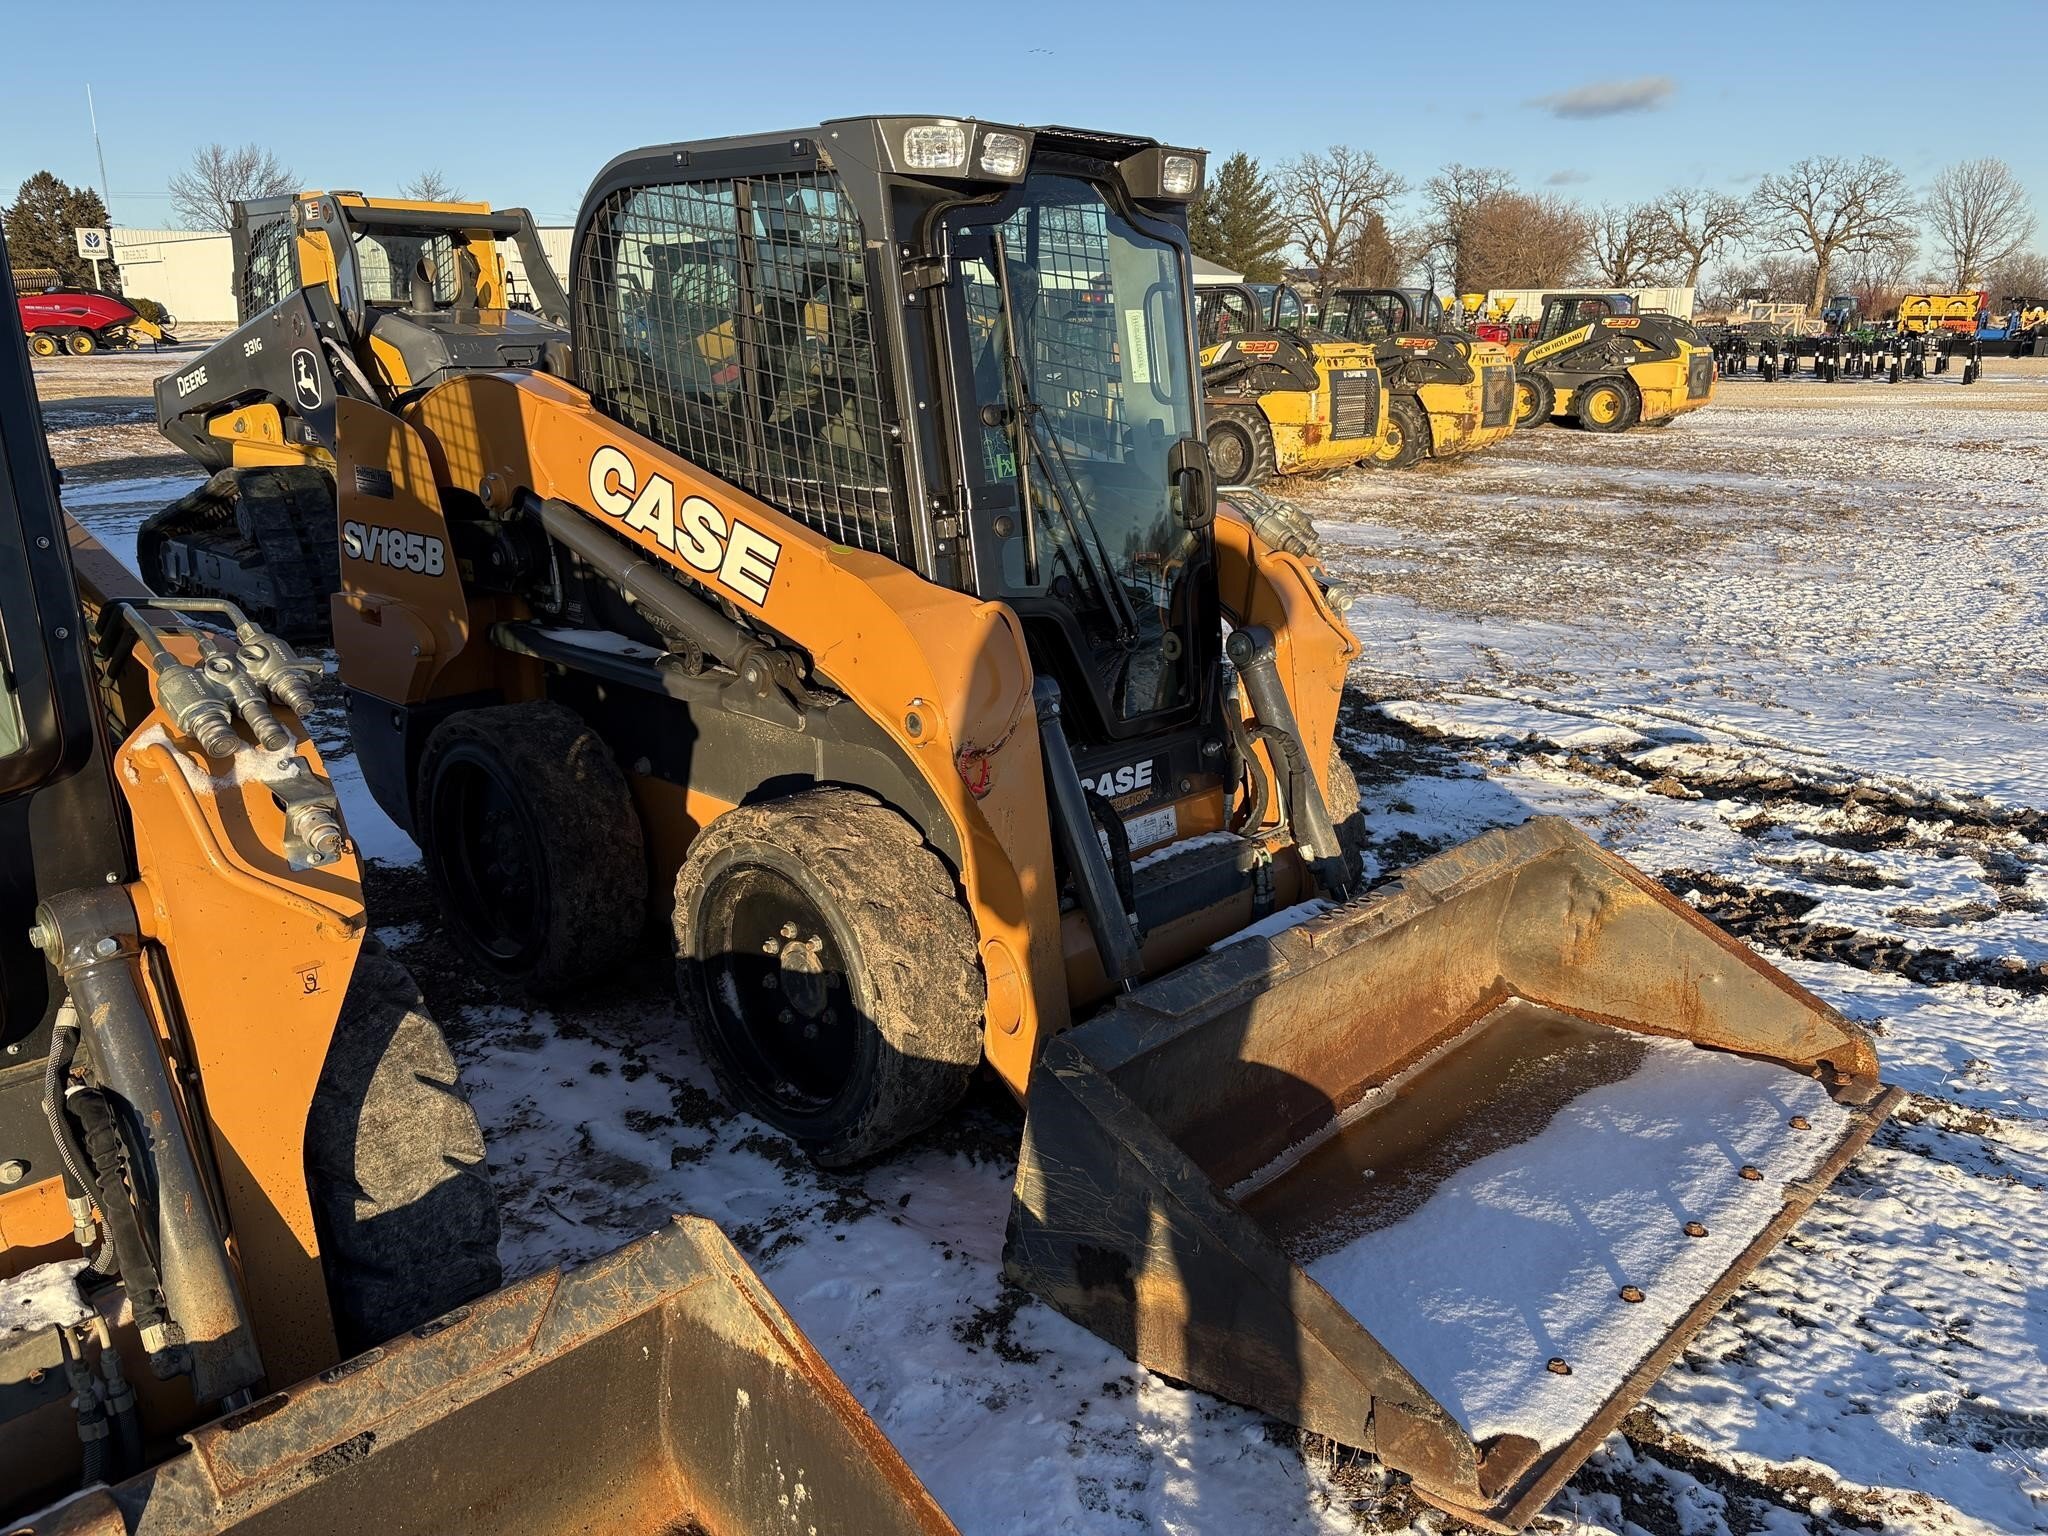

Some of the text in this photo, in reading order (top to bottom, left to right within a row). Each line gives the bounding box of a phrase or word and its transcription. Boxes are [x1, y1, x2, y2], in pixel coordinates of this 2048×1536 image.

[1602, 318, 1640, 328] L230
[243, 337, 263, 357] 331G
[1236, 341, 1279, 353] L320
[1535, 332, 1582, 356] NEW HOLLAND
[176, 365, 209, 398] DEERE
[588, 445, 783, 608] CASE
[343, 520, 446, 577] SV185B
